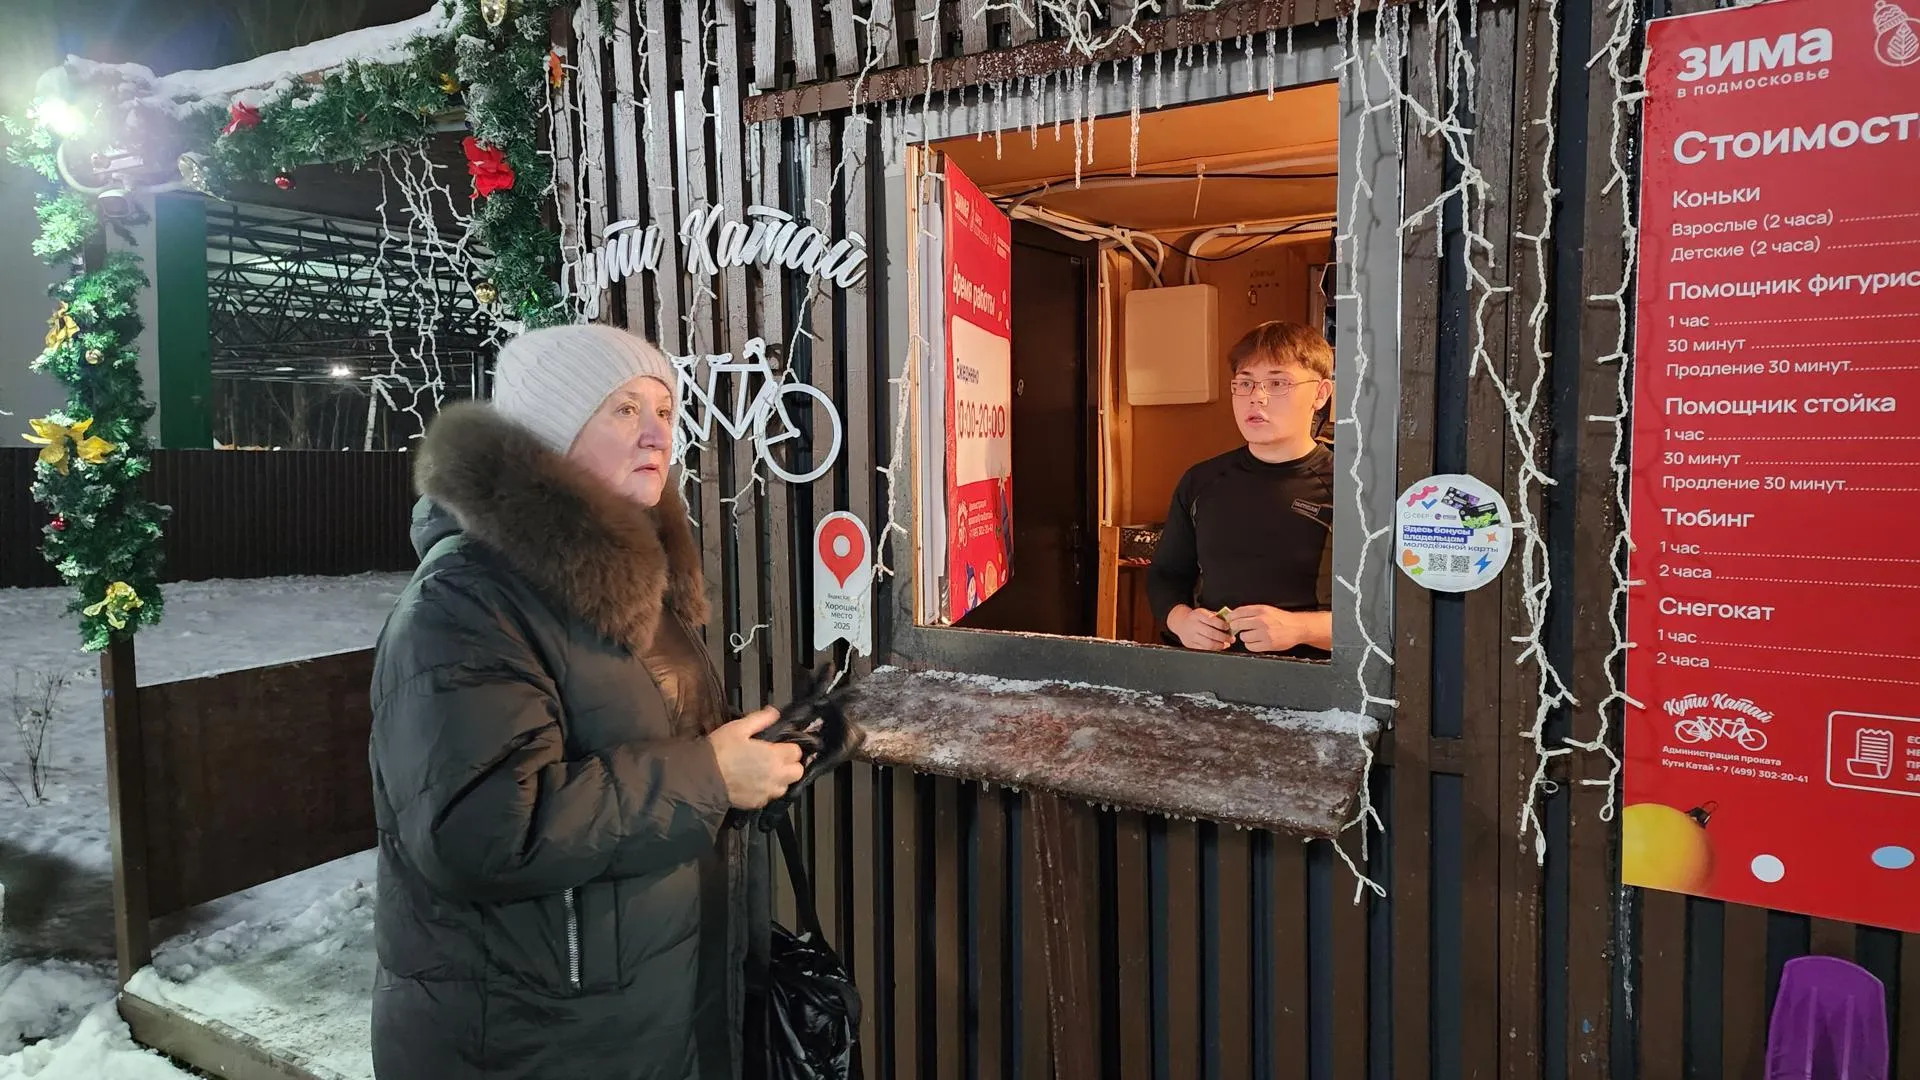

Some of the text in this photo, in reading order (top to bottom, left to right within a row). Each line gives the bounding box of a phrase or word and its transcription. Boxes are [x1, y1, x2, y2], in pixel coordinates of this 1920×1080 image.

[1677, 88, 1686, 98] в
[1674, 112, 1920, 165] Стоимост
[1673, 187, 1760, 208] Коньки
[1672, 208, 1833, 238] Взрослые (2 часа)
[680, 203, 869, 289] Катай
[1670, 236, 1820, 262] Детские (2 часа)
[953, 262, 996, 317] Время работы
[1669, 278, 1802, 300] Помощник
[1668, 315, 1710, 328] 1 час
[1667, 338, 1746, 353] 30 минут
[1666, 360, 1851, 380] Продление 30 минут
[1665, 393, 1896, 416] Помощник стойка
[1664, 428, 1704, 441] 1 час
[1663, 452, 1741, 468] 30 минут
[1663, 475, 1846, 494] Продление 30 минут
[1661, 508, 1755, 528] Тюбинг
[1404, 525, 1471, 535] Здесь бонусы
[1404, 535, 1464, 543] владельцам
[1659, 541, 1700, 555] 1 час
[1659, 564, 1712, 579] 2 часа
[1659, 597, 1775, 621] Снегокат
[833, 622, 850, 630] 2025
[1658, 629, 1697, 644] 1 час
[1657, 652, 1710, 668] 2 часа
[1663, 693, 1776, 724] Кути Катай
[1662, 746, 1782, 767] Администрация проката
[1662, 758, 1685, 769] Кути
[1686, 761, 1714, 772] Катай
[1730, 766, 1756, 778] (499)
[1758, 770, 1809, 784] 302-20-41
